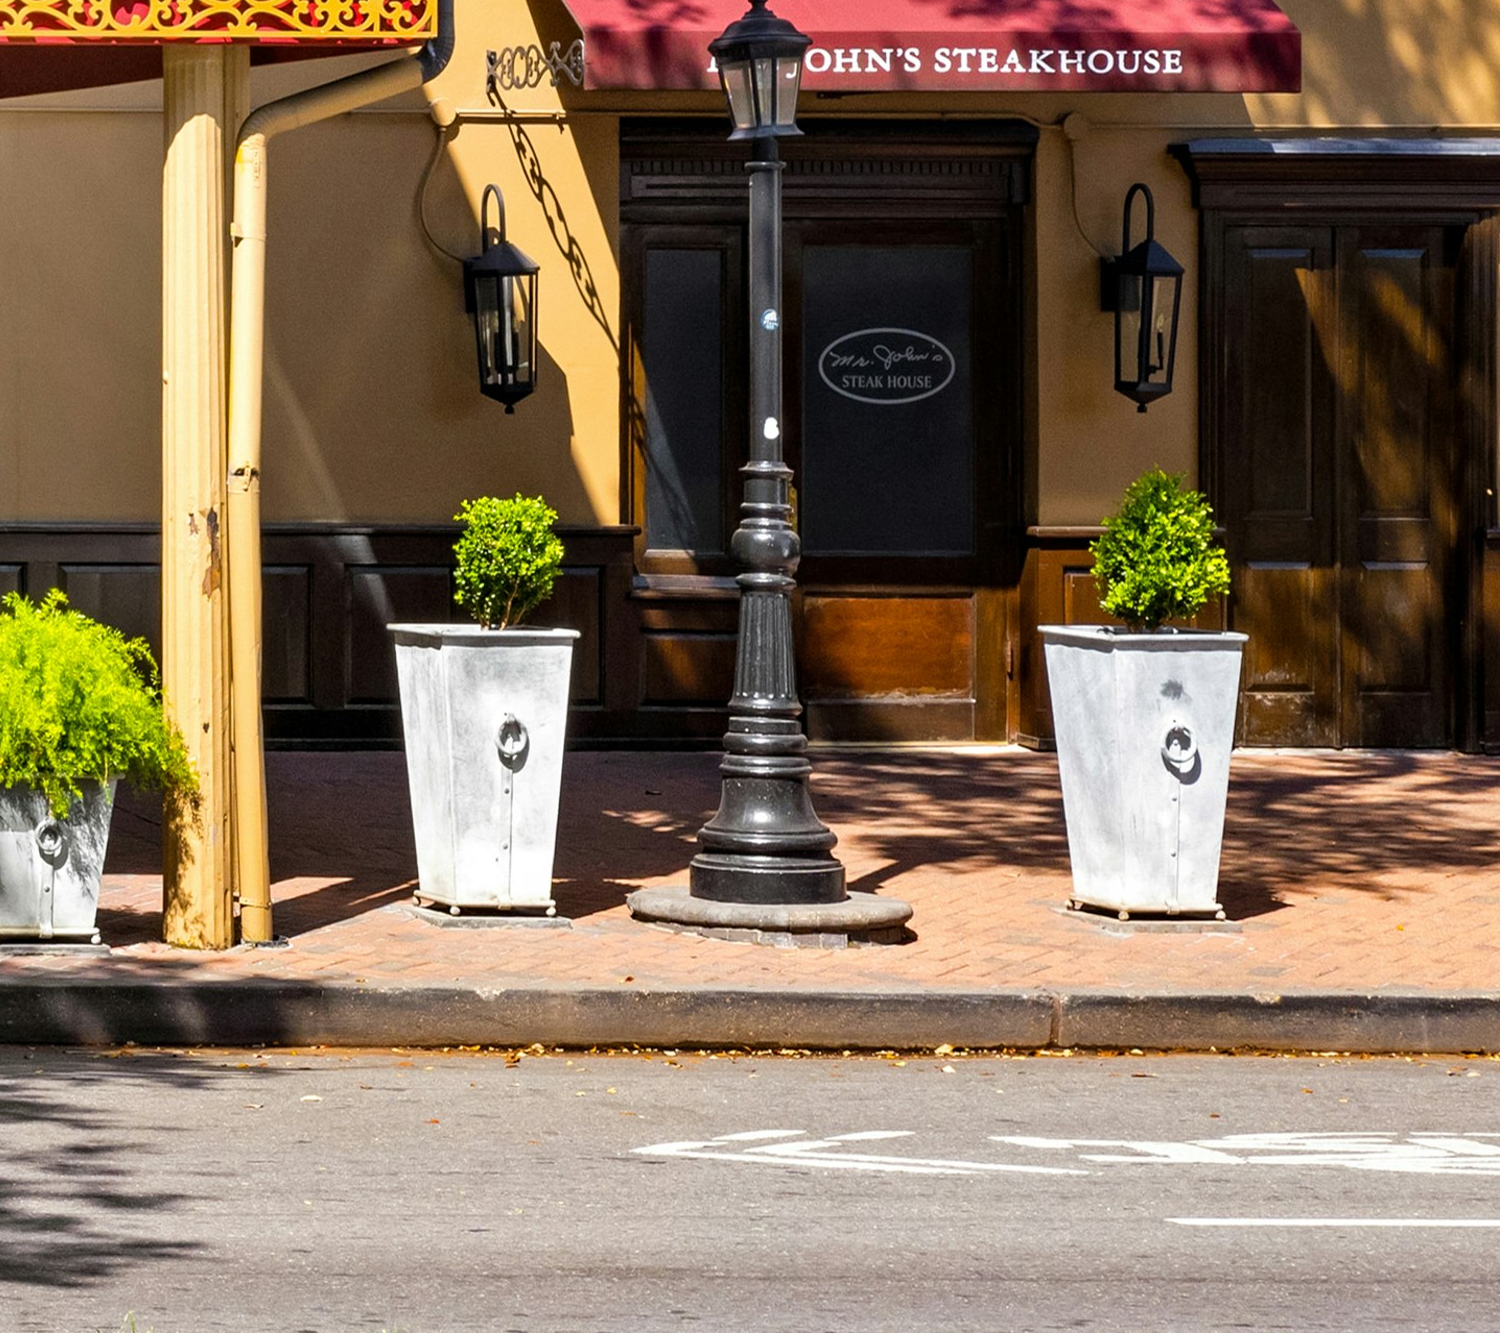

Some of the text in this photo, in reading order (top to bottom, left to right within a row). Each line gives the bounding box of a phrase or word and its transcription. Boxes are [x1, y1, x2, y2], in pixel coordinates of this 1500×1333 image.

[934, 47, 1183, 74] STEAKHOUSE
[829, 344, 943, 370] Mr. John's
[842, 375, 932, 389] STEAK HOUSE
